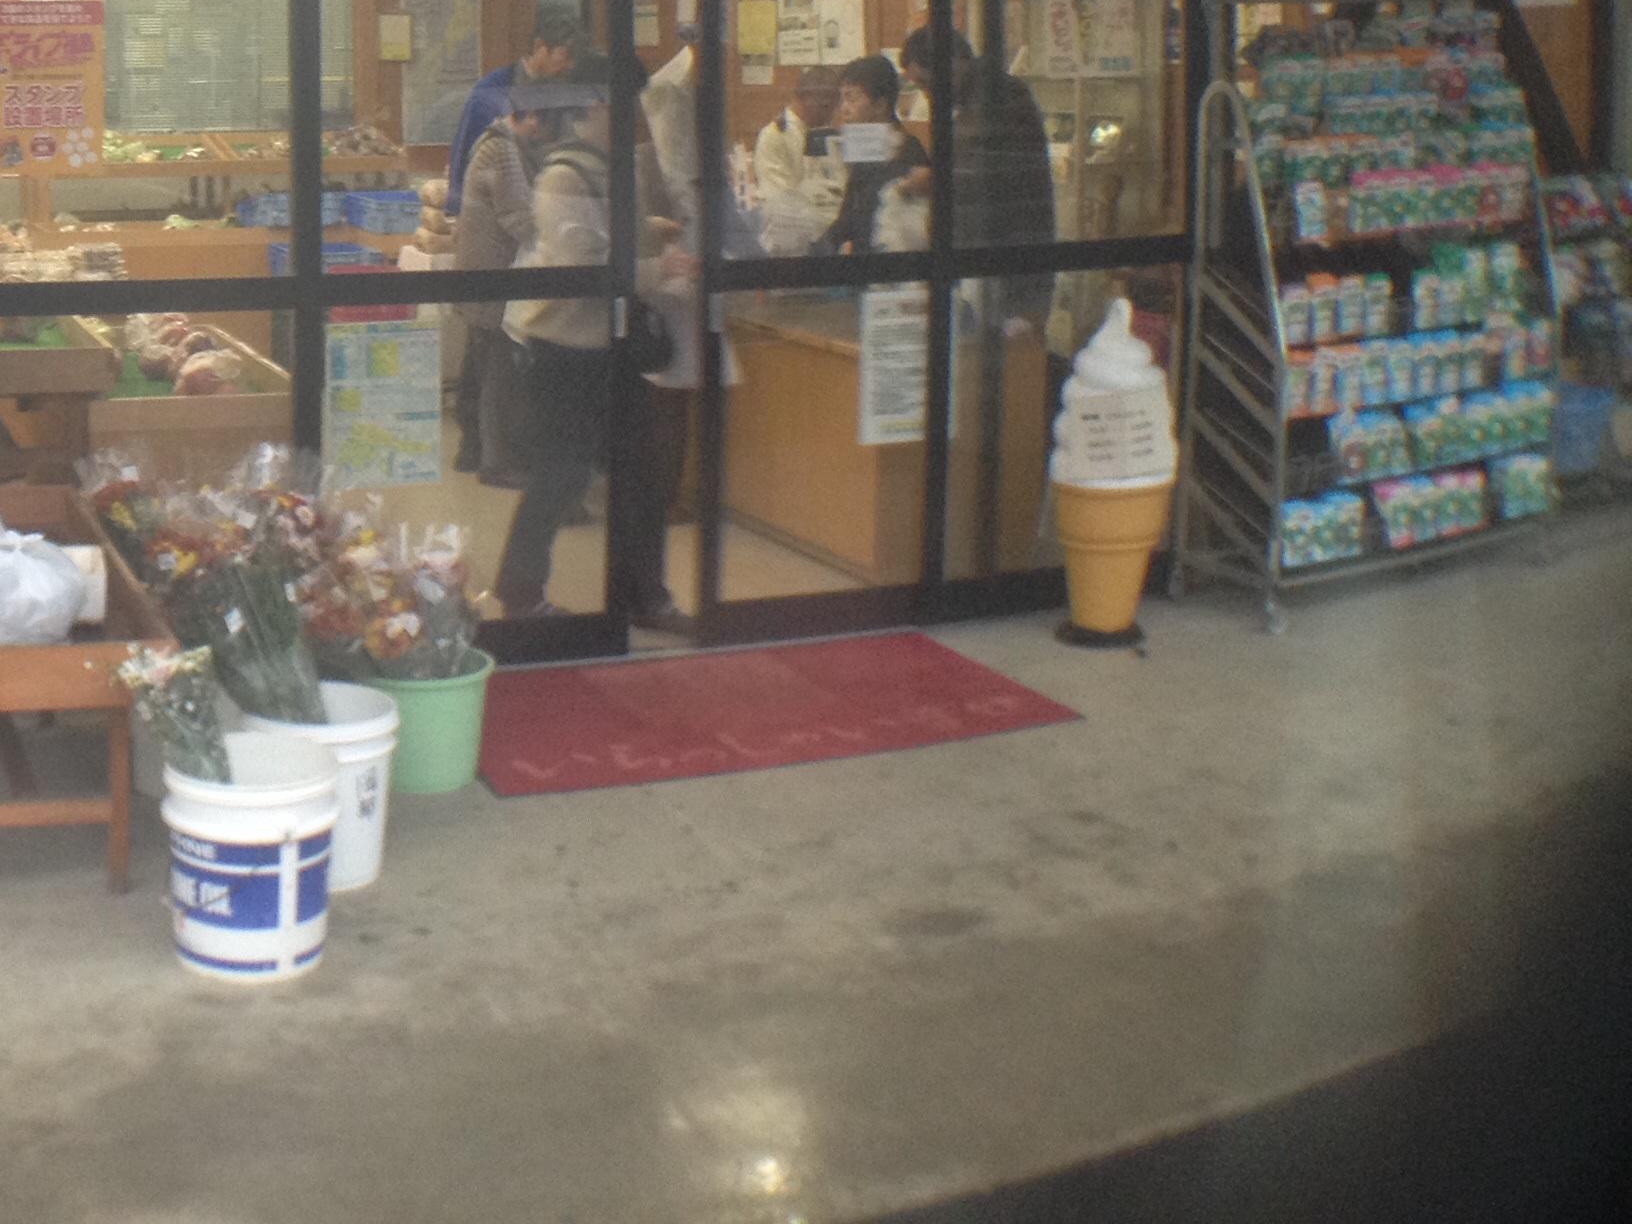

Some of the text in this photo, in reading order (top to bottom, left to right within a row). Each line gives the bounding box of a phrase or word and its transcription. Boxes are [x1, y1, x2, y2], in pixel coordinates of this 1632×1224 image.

[4, 83, 85, 105] スタンプ
[3, 105, 85, 127] 設置場所
